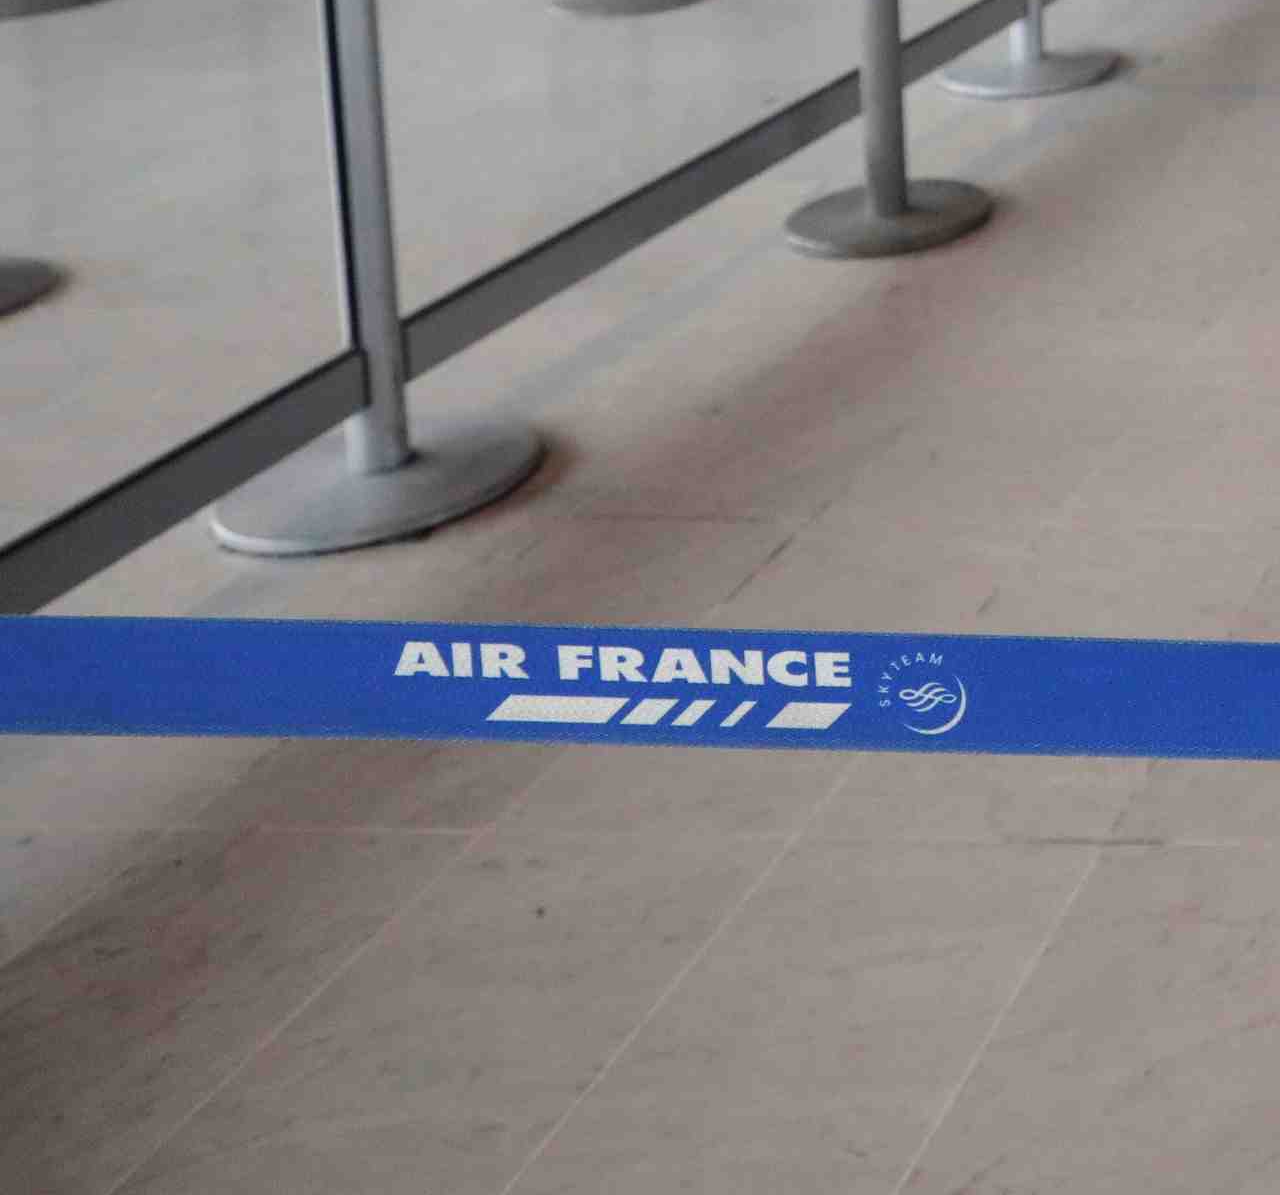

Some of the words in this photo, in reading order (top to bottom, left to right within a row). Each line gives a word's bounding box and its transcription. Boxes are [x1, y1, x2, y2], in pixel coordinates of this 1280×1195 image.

[395, 642, 528, 678] AIR
[558, 645, 851, 687] FRANCE
[878, 651, 944, 708] SKYTEAM
